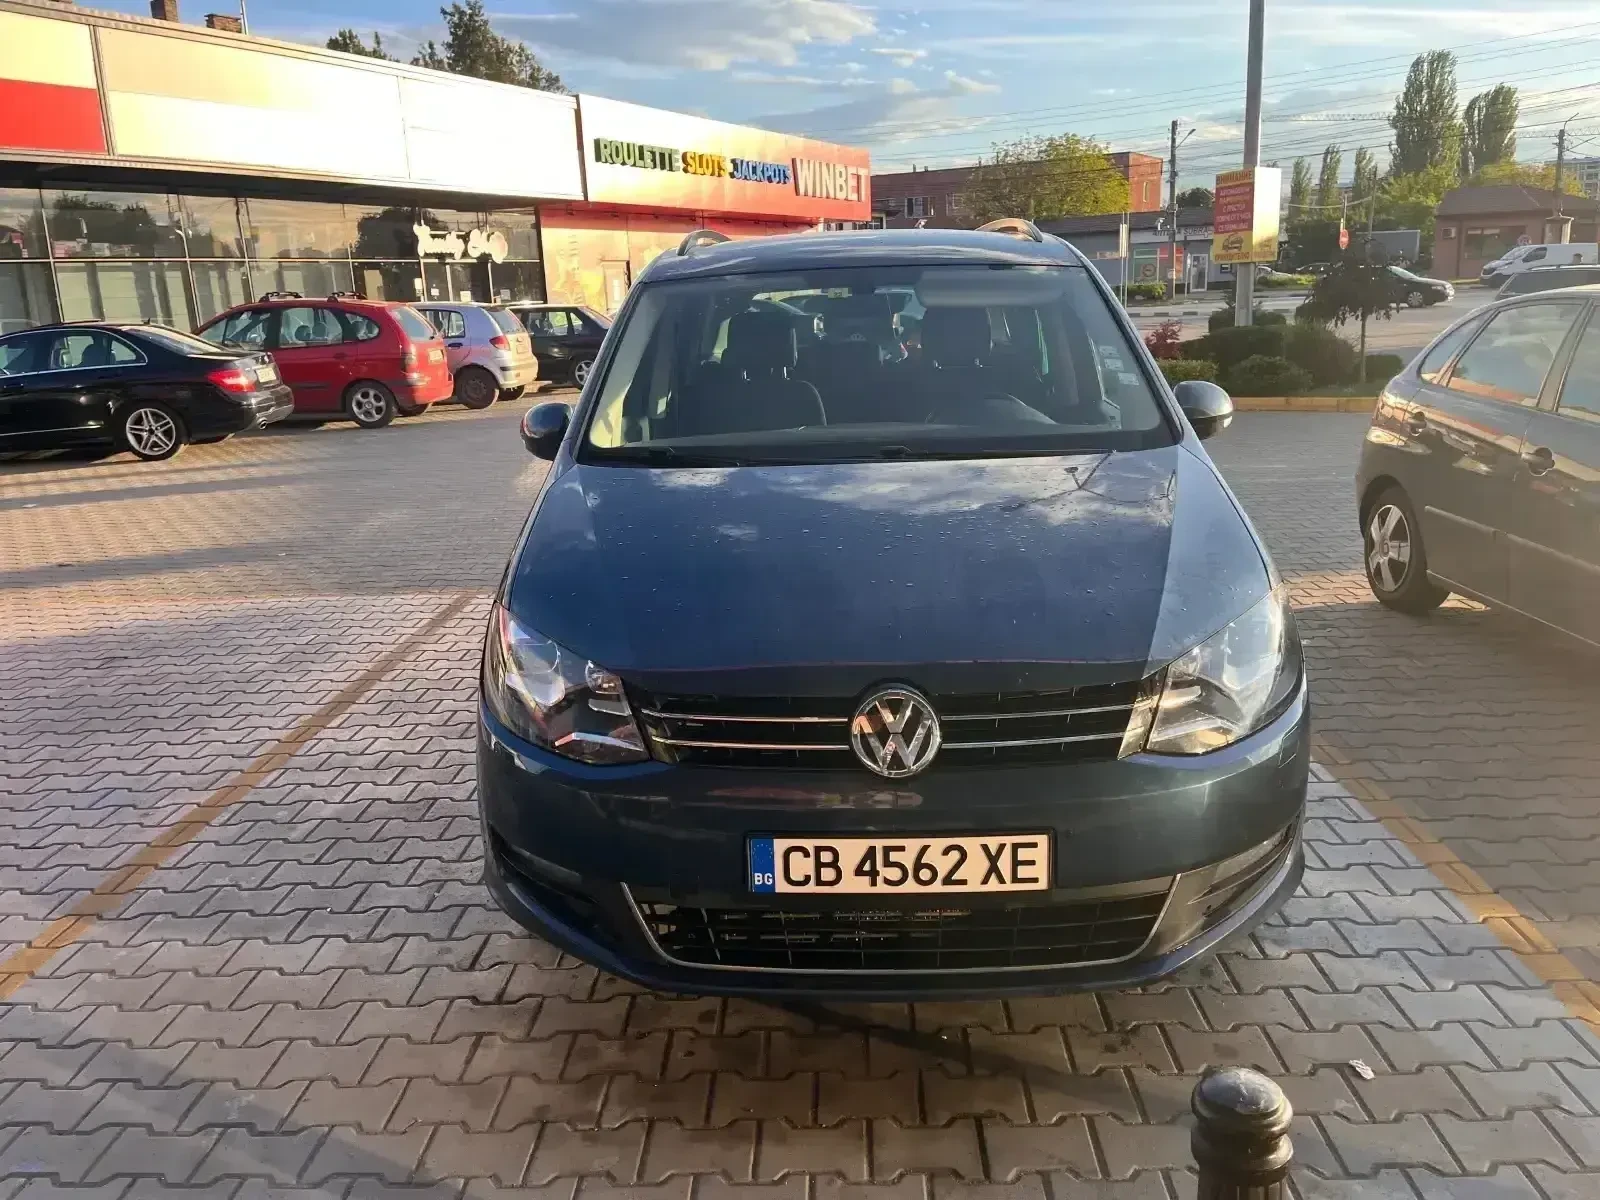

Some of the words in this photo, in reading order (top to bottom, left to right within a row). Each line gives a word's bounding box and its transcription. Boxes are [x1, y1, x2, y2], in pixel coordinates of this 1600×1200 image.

[594, 138, 680, 172] ROULETTE
[681, 151, 728, 177] SLOTS
[729, 158, 792, 185] JACKPOTS
[792, 157, 869, 202] WINBET
[754, 872, 773, 885] BG
[782, 845, 843, 887] CB
[854, 844, 968, 887] 4562
[979, 842, 1039, 885] XE
